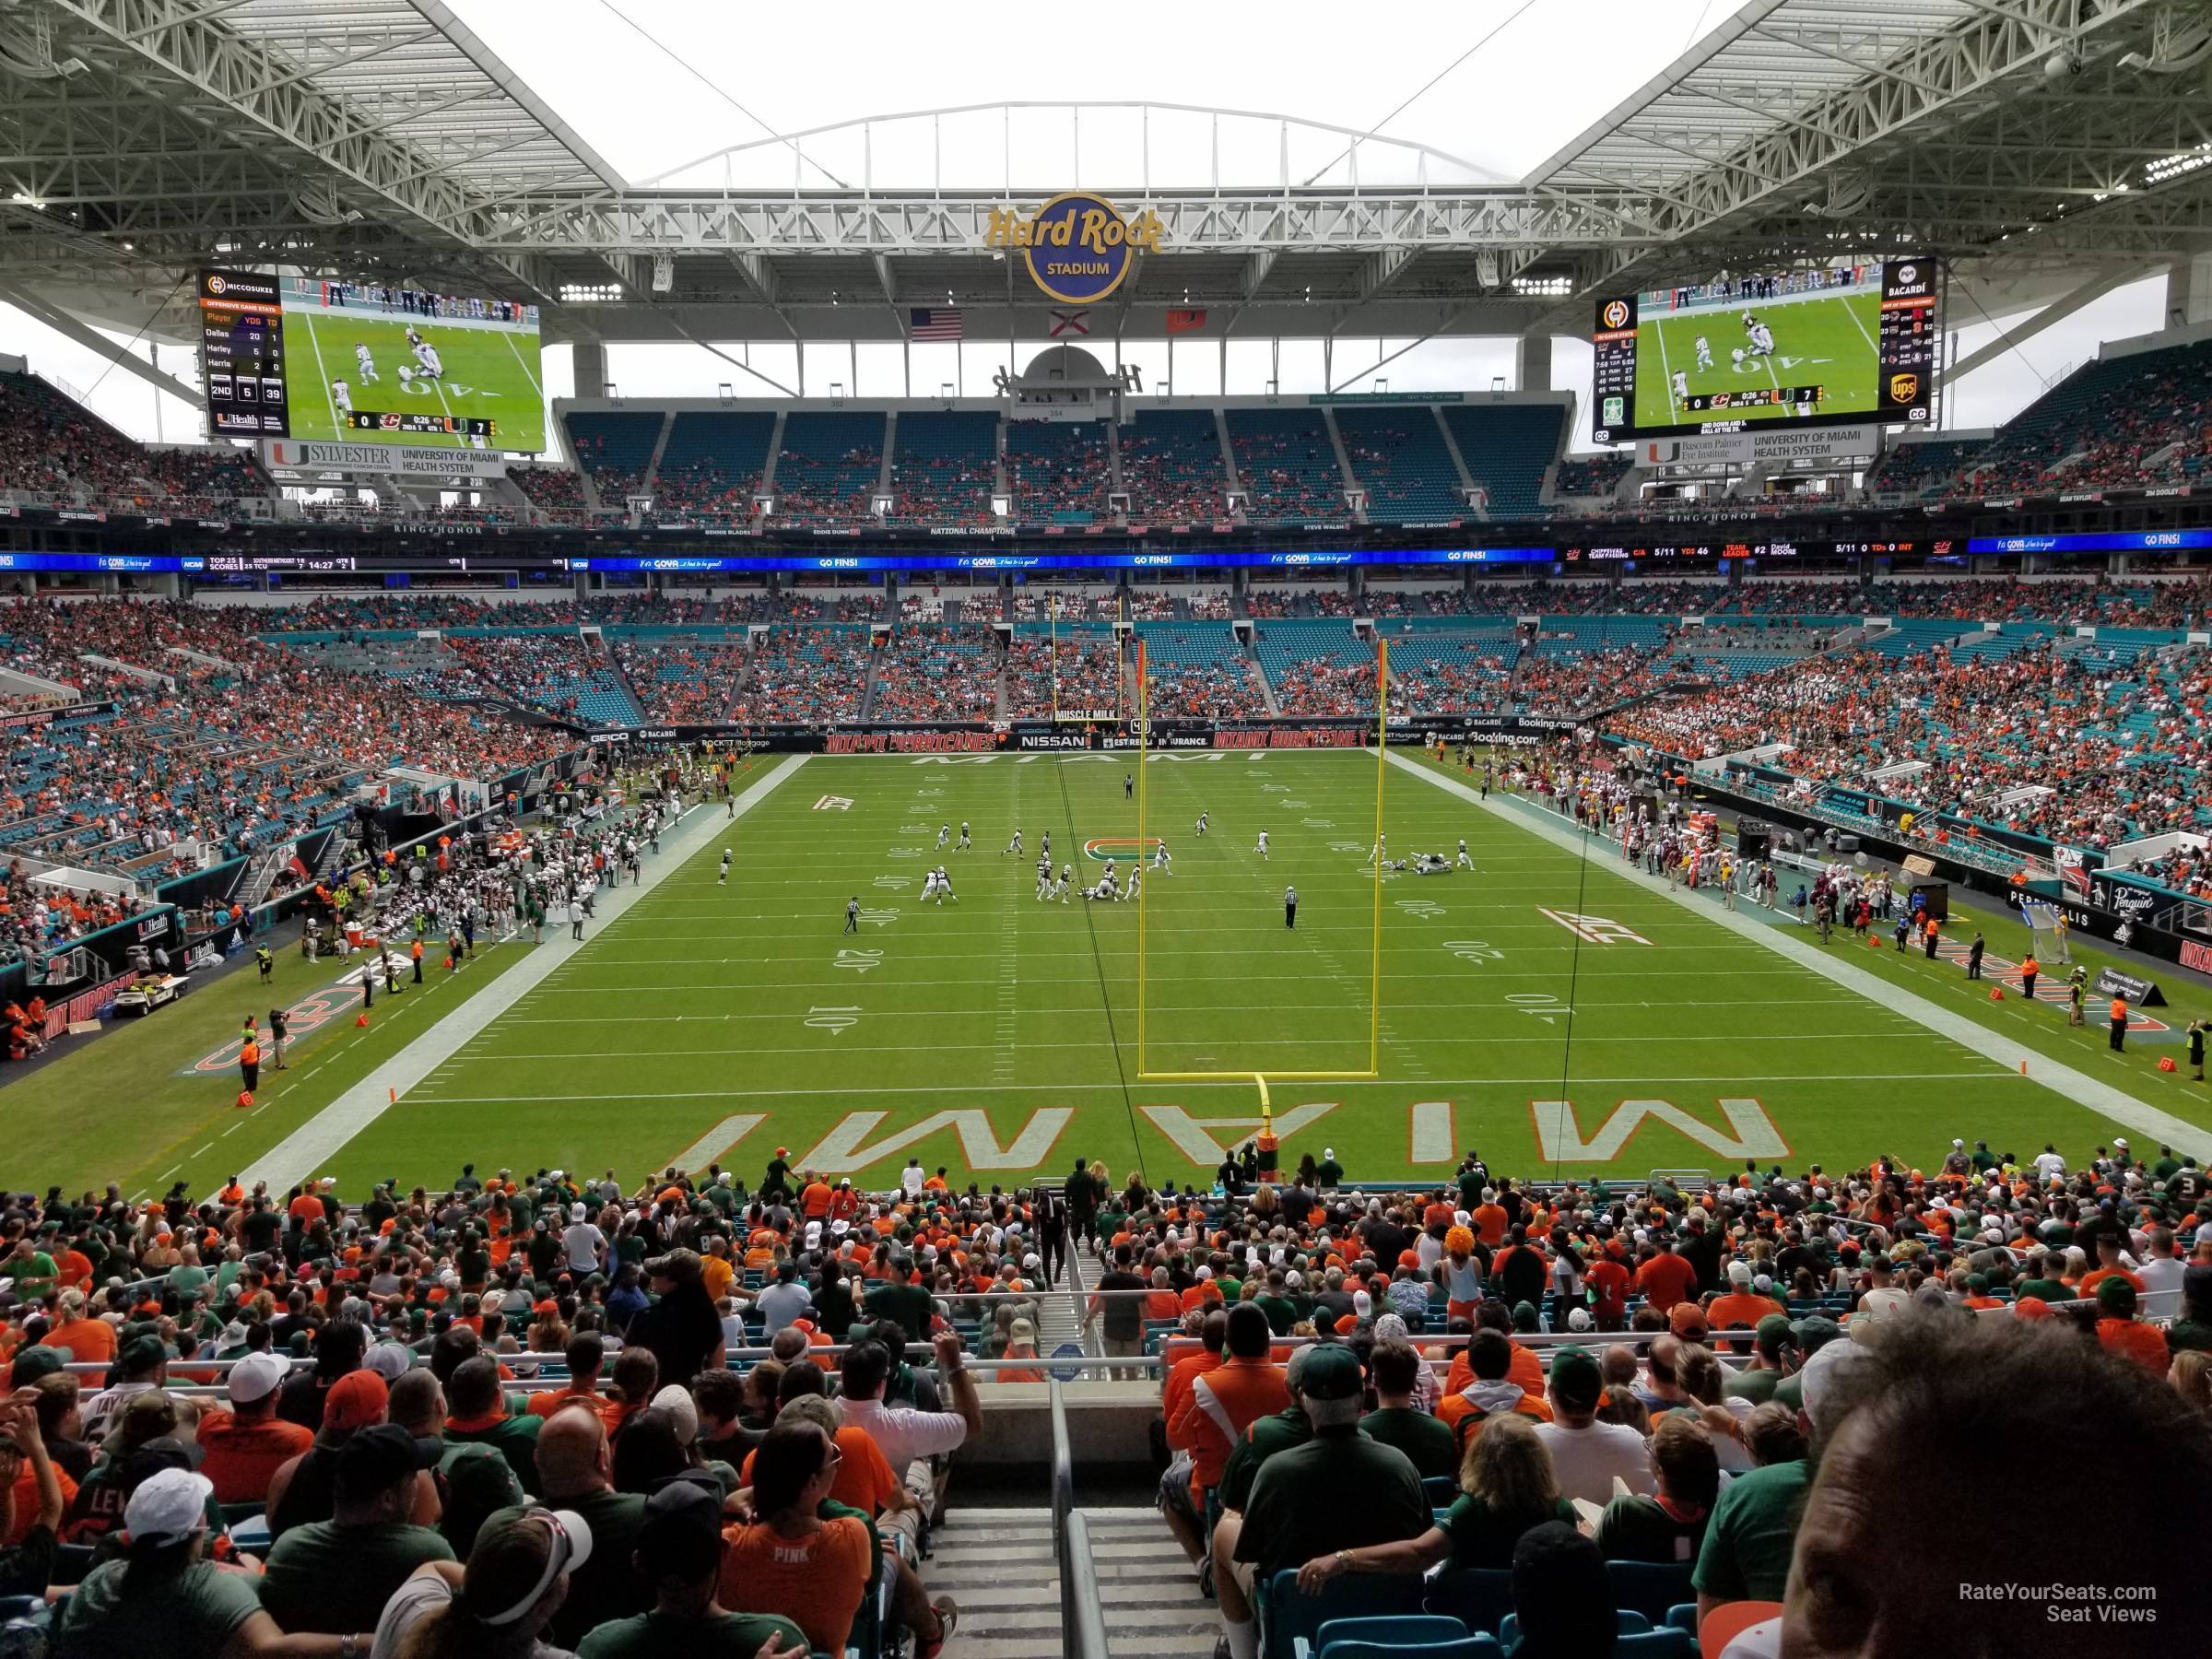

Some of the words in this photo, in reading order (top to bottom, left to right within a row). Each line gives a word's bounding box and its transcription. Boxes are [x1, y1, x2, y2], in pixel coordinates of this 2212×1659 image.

[986, 206, 1077, 247] Hard
[1080, 208, 1163, 254] Rock
[1047, 262, 1109, 275] STADIUM
[227, 283, 273, 294] MICCOSUKEE
[1889, 282, 1926, 296] BACARDÍ
[207, 301, 239, 309] OFFENSIVE
[207, 313, 231, 322] Player
[245, 317, 261, 325] YDS
[206, 329, 229, 337] Dallas
[207, 345, 231, 354] Harley
[208, 359, 231, 367] Harris
[212, 386, 231, 395] 2ND
[244, 388, 251, 397] 5
[266, 389, 280, 398] 39
[1894, 382, 1914, 398] ups
[1694, 399, 1701, 408] 0
[1742, 392, 1757, 400] 0:26
[1771, 388, 1794, 404] U
[1805, 390, 1811, 400] 7
[1911, 410, 1924, 418] CC
[361, 416, 368, 427] 0
[444, 417, 468, 434] U
[478, 423, 484, 433] 7
[1755, 434, 1810, 446] UNIVERSITY
[1812, 433, 1825, 442] OF
[1827, 431, 1860, 441] MIAMI
[273, 442, 309, 465] U
[311, 445, 390, 464] SYLVESTER
[402, 449, 454, 461] UNIVERSITY
[456, 452, 468, 461] OF
[470, 453, 498, 463] MIAMI
[1649, 442, 1680, 462] U
[1682, 441, 1712, 451] Bascom
[1714, 440, 1741, 448] Palmer
[1682, 452, 1695, 462] Eye
[1698, 449, 1730, 459] Institute
[1754, 448, 1790, 457] HEALTH
[1792, 445, 1830, 455] SYSTEM
[403, 461, 437, 471] HEALTH
[439, 463, 474, 473] SYSTEM
[1712, 512, 1757, 521] HONOR
[394, 525, 427, 533] RING
[2007, 540, 2024, 549] GOYA
[2145, 535, 2160, 546] GO
[2161, 534, 2180, 545] FINS!
[1836, 544, 1855, 553] 5/11
[0, 557, 13, 567] NS!
[1134, 556, 1147, 564] GO
[1149, 556, 1172, 564] FINS!
[1447, 552, 1460, 560] GO
[1463, 551, 1486, 560] FINS!
[820, 559, 833, 567] GO
[835, 558, 858, 567] FINS!
[1056, 710, 1092, 719] MUSCLE
[1094, 709, 1115, 719] MILK
[1519, 718, 1576, 730] Booking.com
[591, 732, 629, 742] GEICO
[648, 729, 676, 738] BACARDÍ
[1022, 736, 1085, 747] NISSAN
[1214, 731, 1268, 748] MIAMI
[1438, 732, 1464, 740] BACARDÍ
[827, 734, 887, 753] MIAMI
[2114, 887, 2153, 912] Penguin
[1394, 900, 1445, 915] 30
[855, 908, 900, 922] 30
[2054, 905, 2088, 926] ELIS
[1535, 904, 1655, 946] ACC
[1443, 941, 1504, 959] 20
[833, 950, 884, 967] 20
[1505, 994, 1577, 1015] 10
[804, 1006, 863, 1027] 10
[654, 1097, 1795, 1179] MIAMI
[1230, 1170, 1235, 1182] 1
[2182, 1177, 2195, 1194] 3
[774, 1546, 810, 1563] PINK
